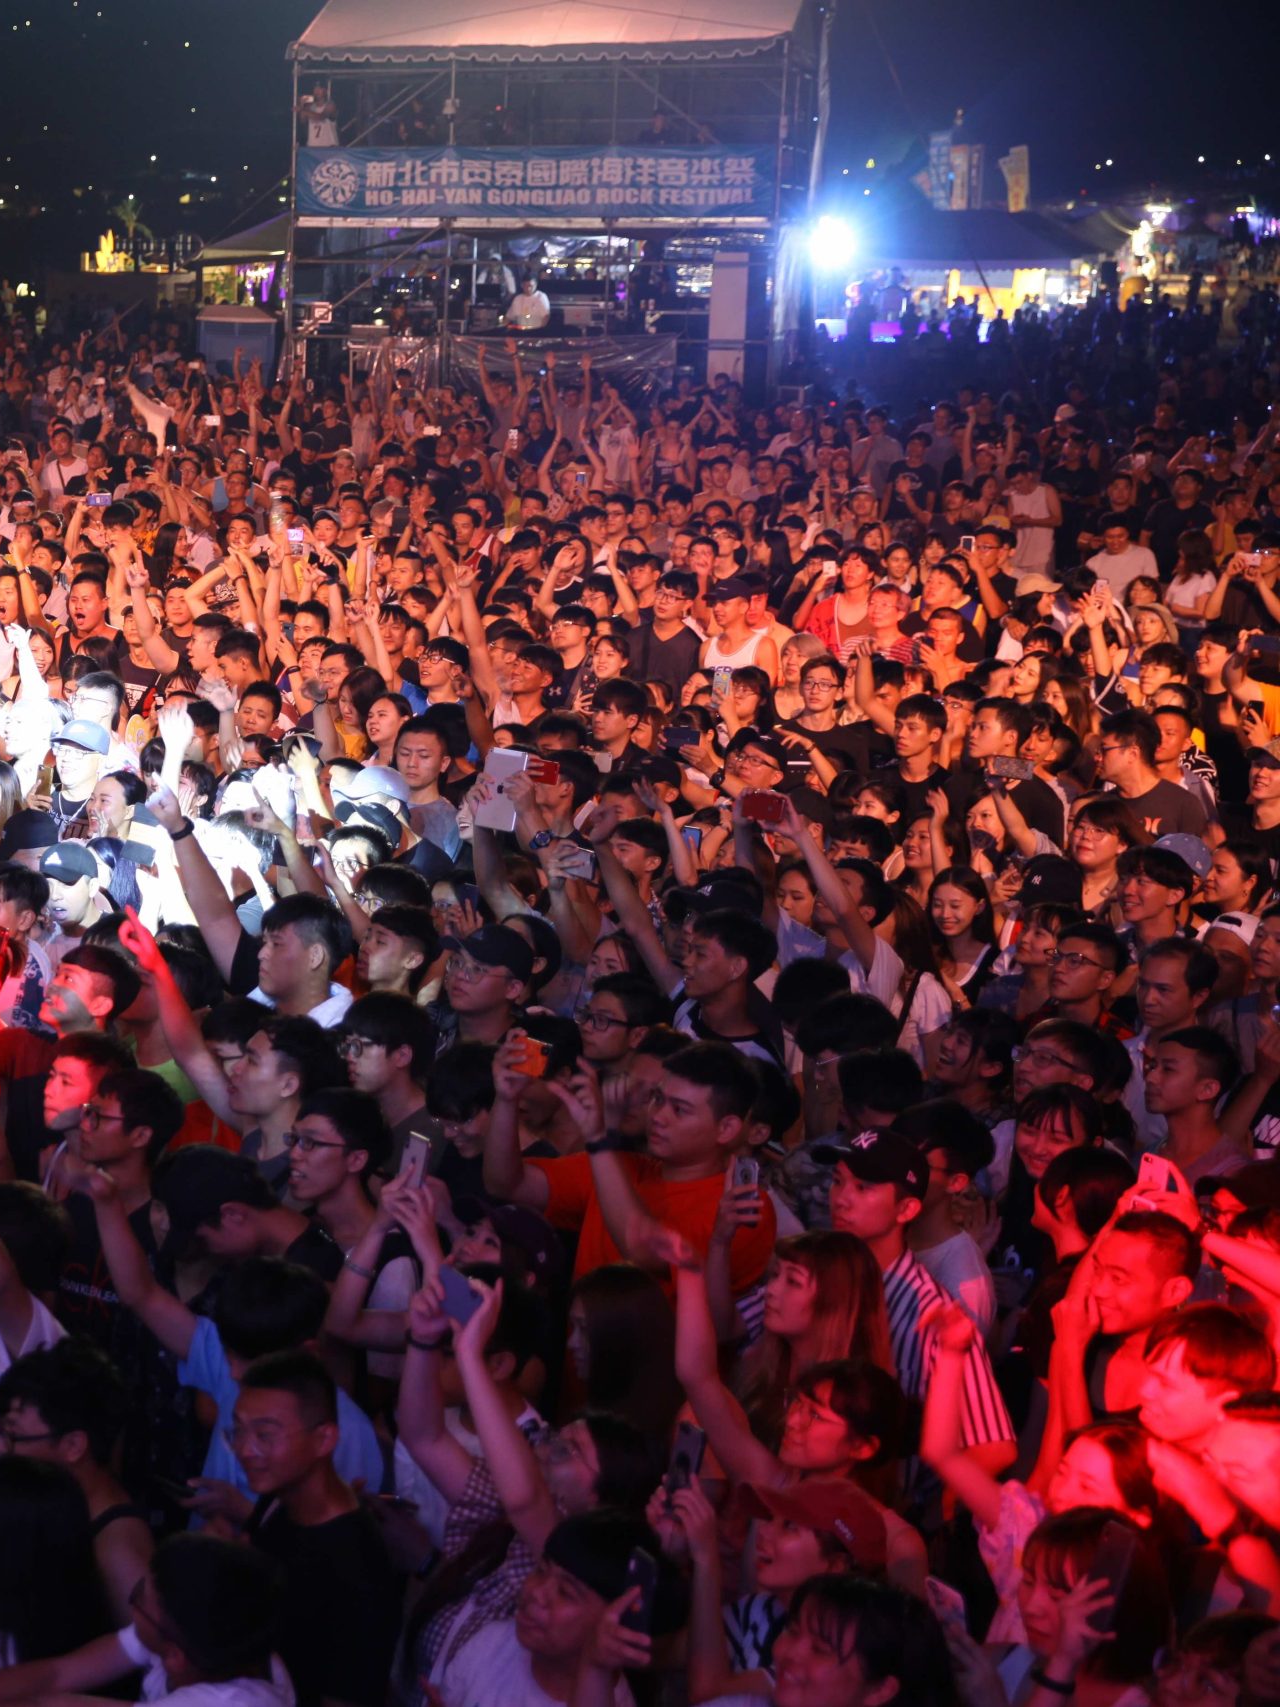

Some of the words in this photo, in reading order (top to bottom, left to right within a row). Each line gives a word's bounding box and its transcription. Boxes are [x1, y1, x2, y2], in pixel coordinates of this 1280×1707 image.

[366, 188, 482, 205] HO-HAI-YAN
[487, 188, 592, 206] GONGLIAO
[595, 187, 654, 205] ROCK
[658, 187, 755, 205] FESTIVAL
